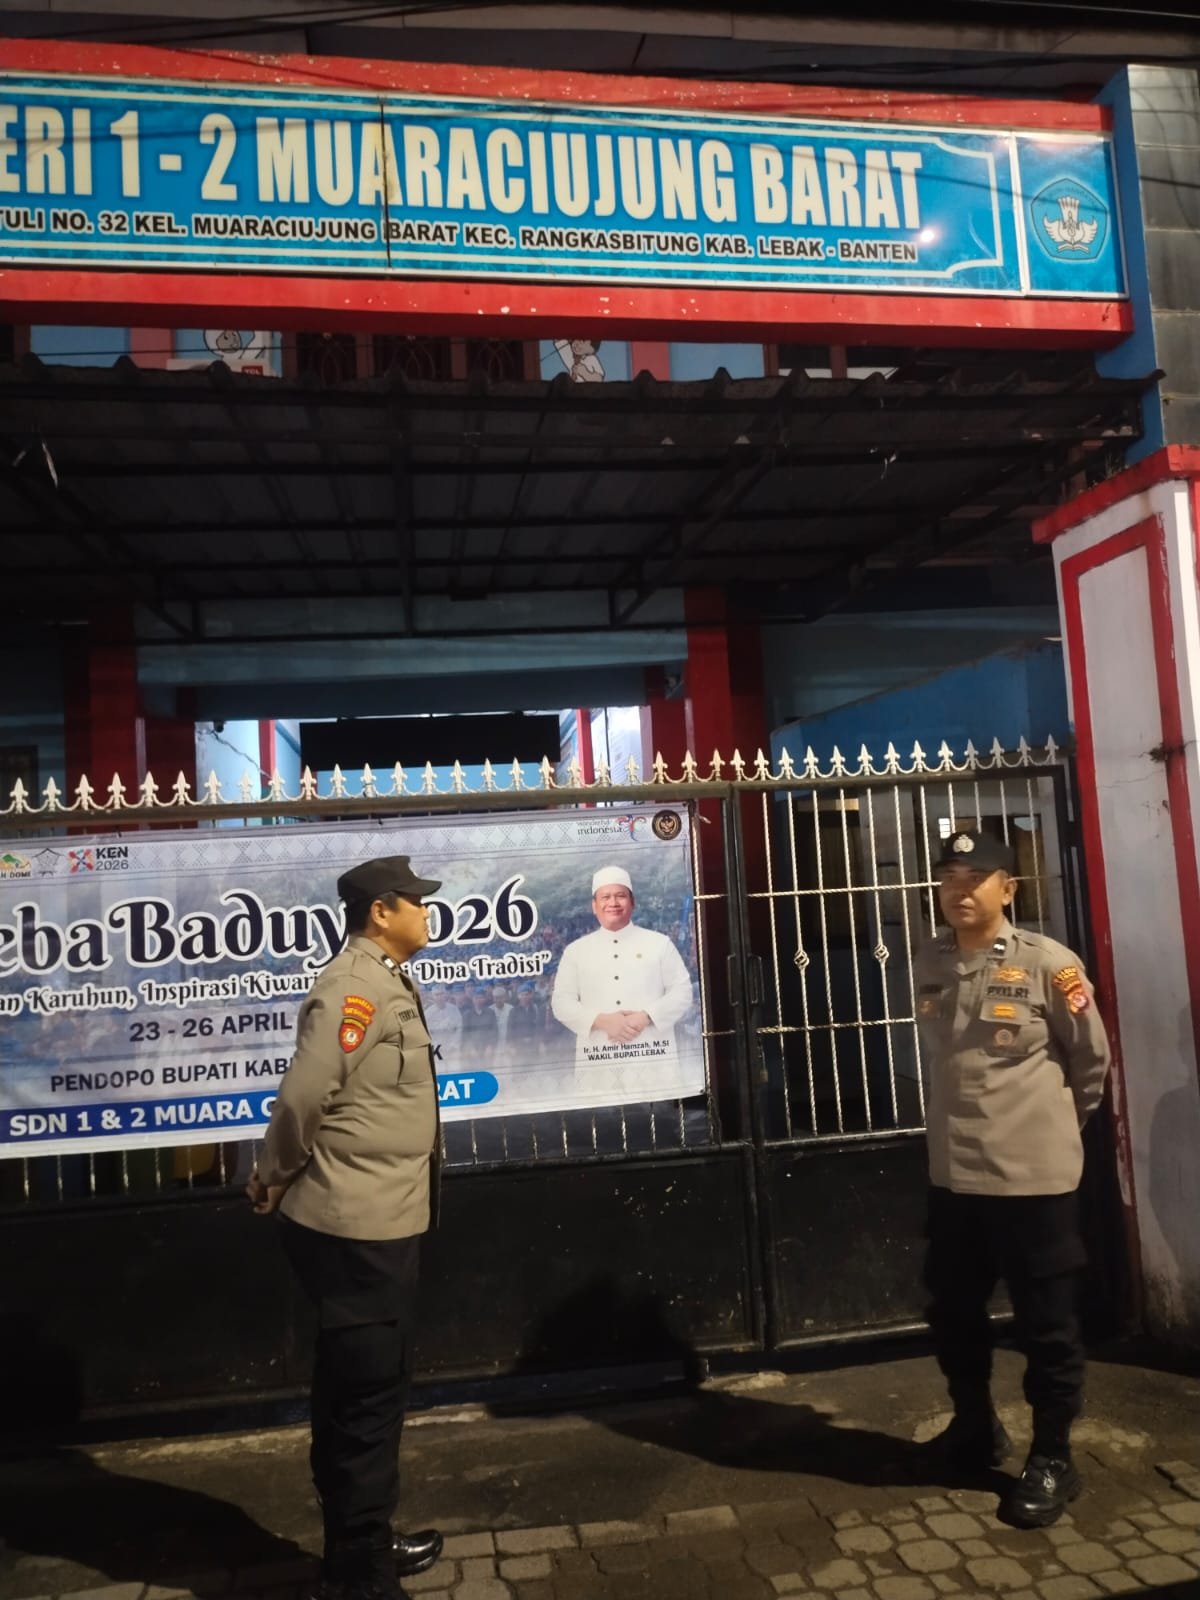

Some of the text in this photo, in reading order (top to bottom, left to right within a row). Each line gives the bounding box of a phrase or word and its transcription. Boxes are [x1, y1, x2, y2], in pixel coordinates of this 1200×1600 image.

[110, 111, 140, 197] 1
[160, 154, 182, 171] -
[200, 113, 237, 200] 2
[256, 117, 737, 223] MUARACIUJUNG
[750, 143, 922, 229] BARAT
[0, 210, 43, 230] ULI
[53, 212, 93, 231] NO.
[101, 214, 127, 232] 32
[135, 215, 187, 233] KEL.
[195, 217, 375, 239] MUARACIUJUNG
[383, 222, 457, 243] BARAT
[466, 227, 514, 245] KEC.
[521, 229, 698, 252] RANGKASBITUNG
[707, 237, 751, 254] KAB.
[760, 240, 822, 257] LEBAK
[840, 242, 916, 260] BANTEN
[95, 860, 129, 871] 2026
[96, 846, 128, 859] KEN
[109, 892, 348, 970] Baduy
[424, 878, 534, 942] 026
[141, 978, 236, 1005] Inspirasi
[416, 962, 466, 981] Dina
[129, 1023, 160, 1042] 23
[182, 1017, 214, 1037] 26
[221, 1012, 292, 1034] APRIL
[588, 1048, 666, 1061] WAKIL BUPATI LEBAK
[602, 1044, 619, 1052] Amir
[51, 1069, 154, 1092] PENDOPO
[162, 1062, 237, 1084] BUPATI
[246, 1057, 293, 1077] KAB
[9, 1114, 67, 1136] SDN
[77, 1112, 92, 1132] 1
[101, 1109, 122, 1130] &
[131, 1108, 147, 1128] 2
[154, 1099, 254, 1126] MUARA
